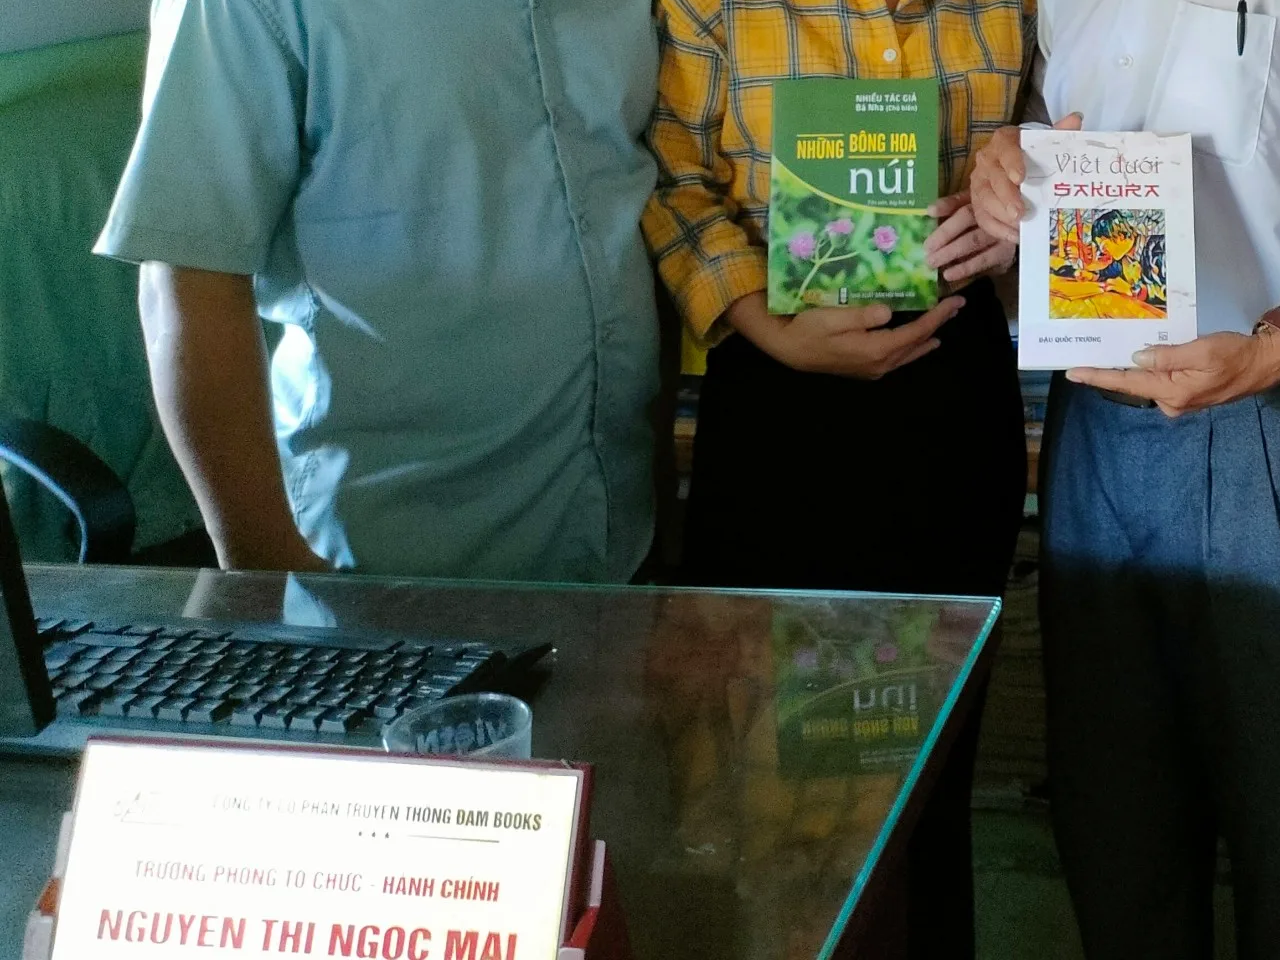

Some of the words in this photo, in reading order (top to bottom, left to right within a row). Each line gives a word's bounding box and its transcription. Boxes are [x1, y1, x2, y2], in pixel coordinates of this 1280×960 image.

[796, 137, 844, 159] NHỮNG
[849, 130, 886, 153] BÔNG
[890, 132, 917, 153] HOA
[849, 158, 915, 195] núi
[1054, 180, 1160, 198] SAKURA
[492, 811, 543, 832] BOOKS
[439, 876, 501, 903] CHÍNH
